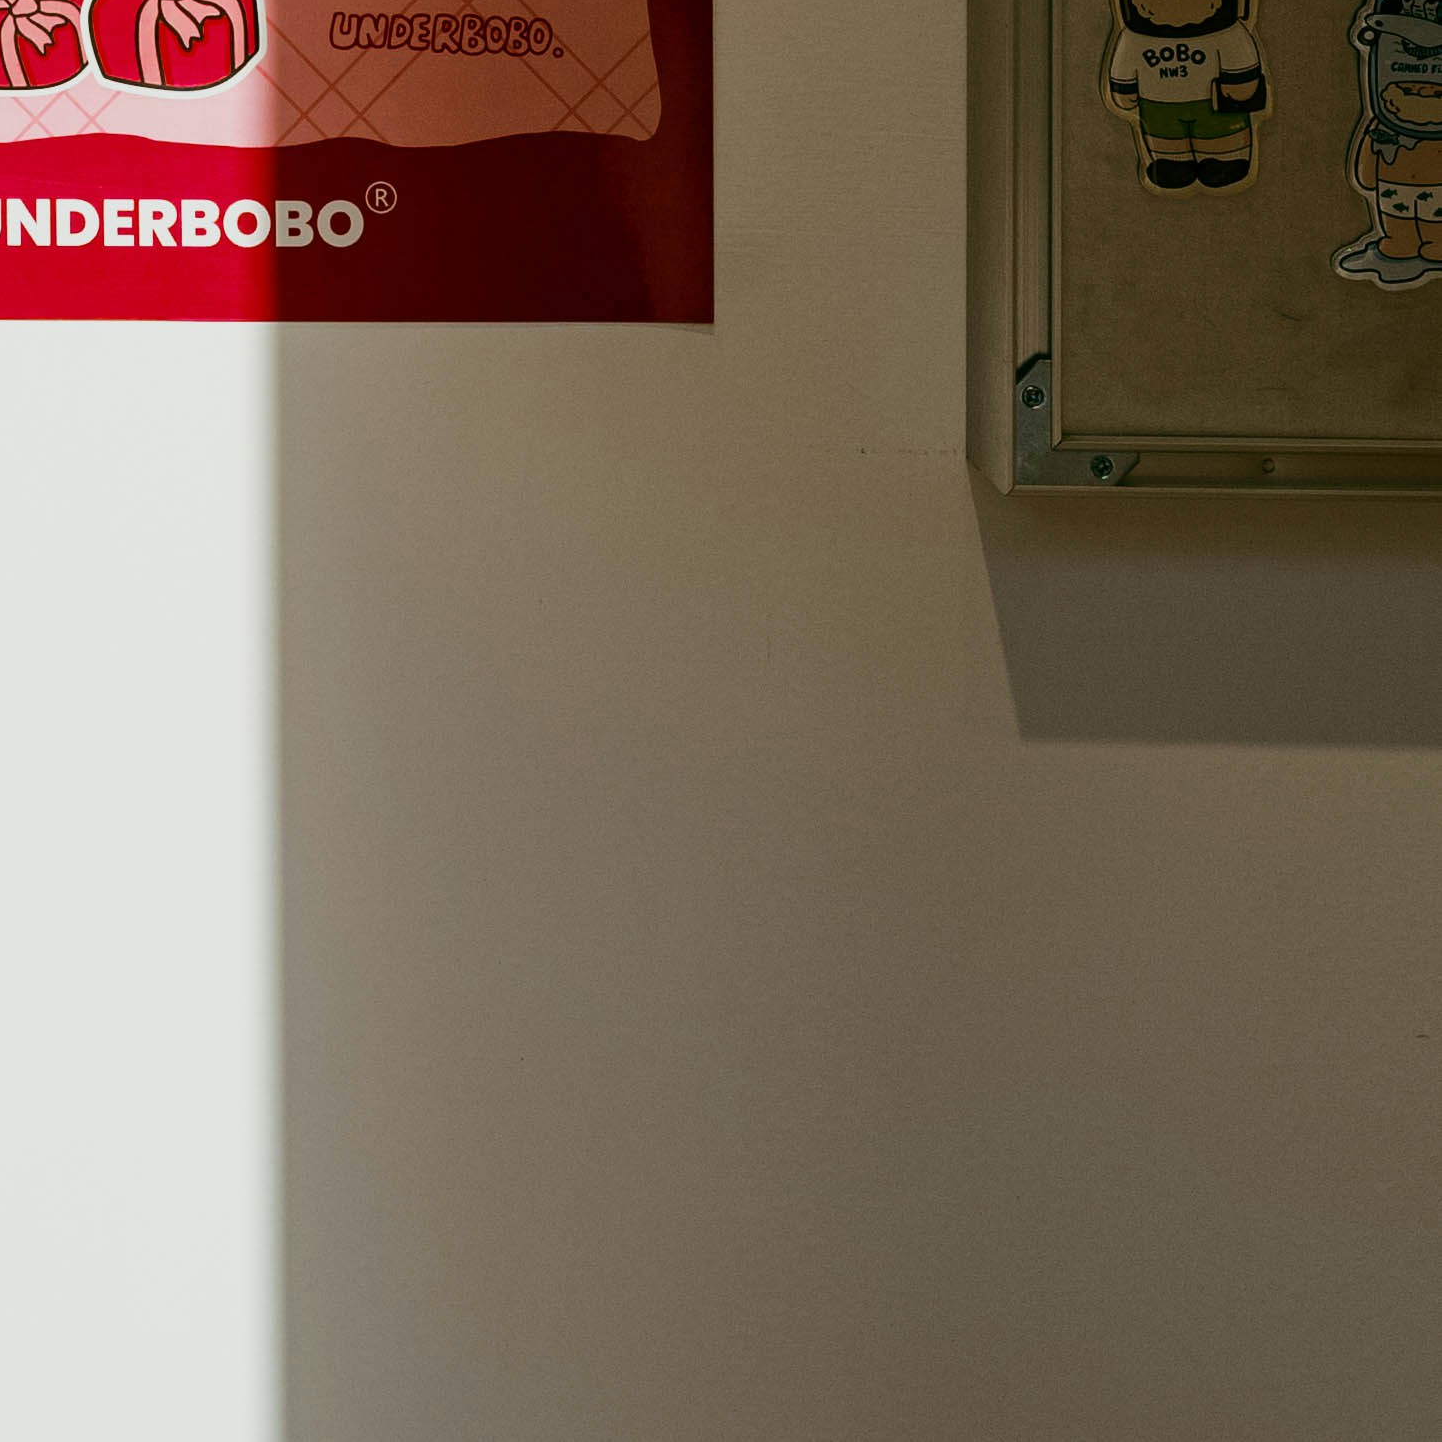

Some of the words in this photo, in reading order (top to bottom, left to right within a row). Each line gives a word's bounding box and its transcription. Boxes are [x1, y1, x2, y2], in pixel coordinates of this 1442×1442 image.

[329, 11, 565, 58] UNDERBOBO.
[1142, 43, 1206, 68] BOBO
[1160, 65, 1189, 79] NW3
